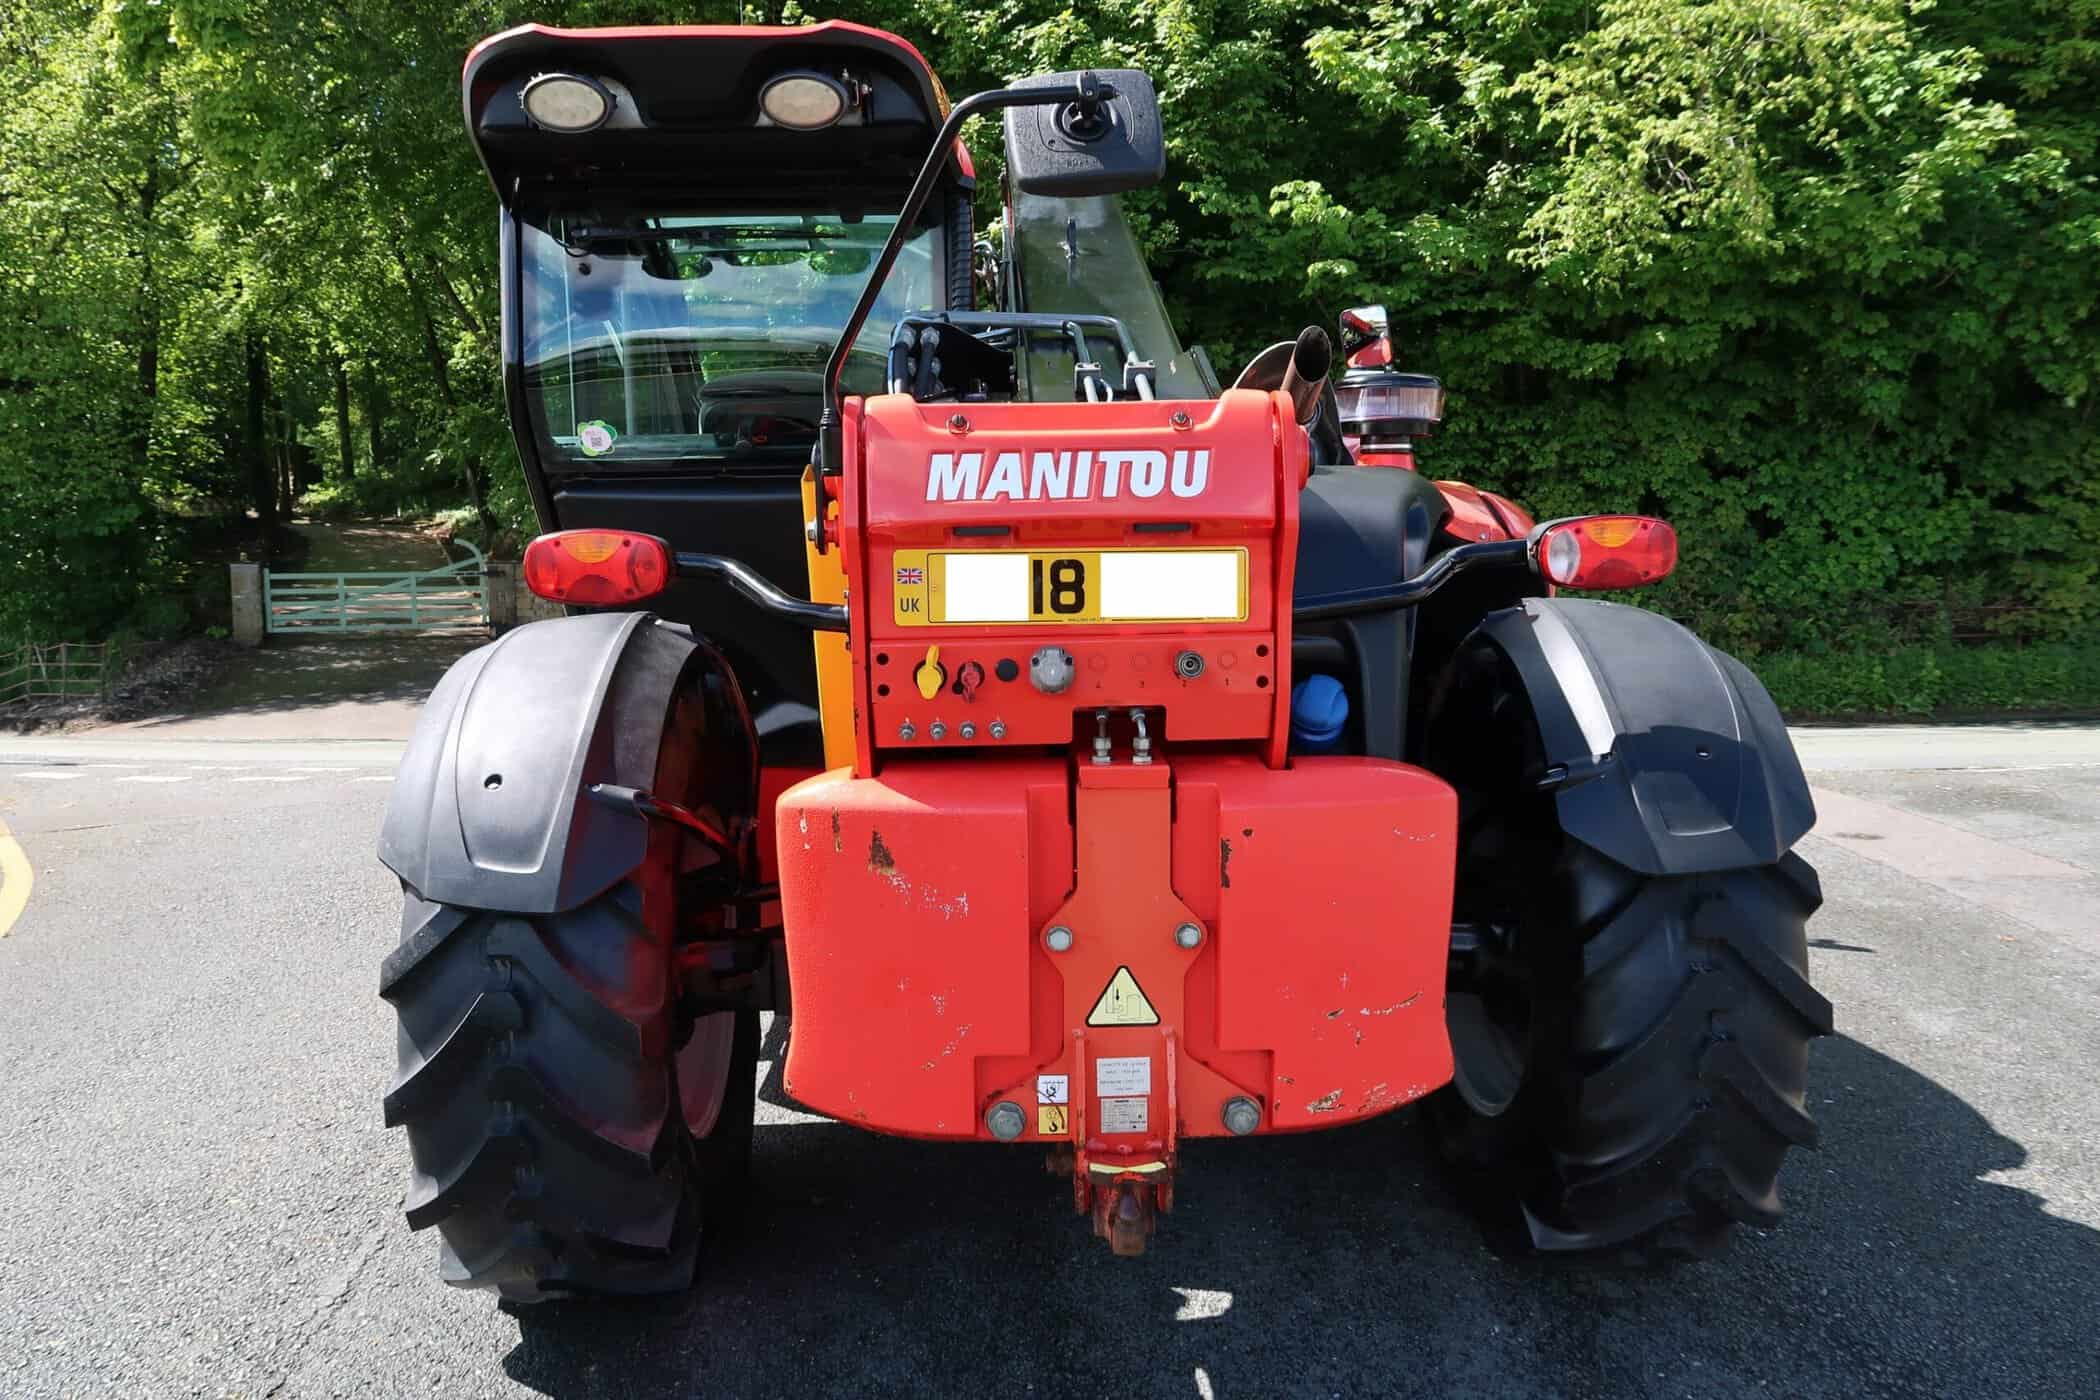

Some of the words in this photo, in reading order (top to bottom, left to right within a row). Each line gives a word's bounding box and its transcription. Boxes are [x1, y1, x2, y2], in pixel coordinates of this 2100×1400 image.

[925, 450, 1209, 501] MANITOU
[900, 597, 920, 613] UK
[1032, 559, 1085, 614] 18
